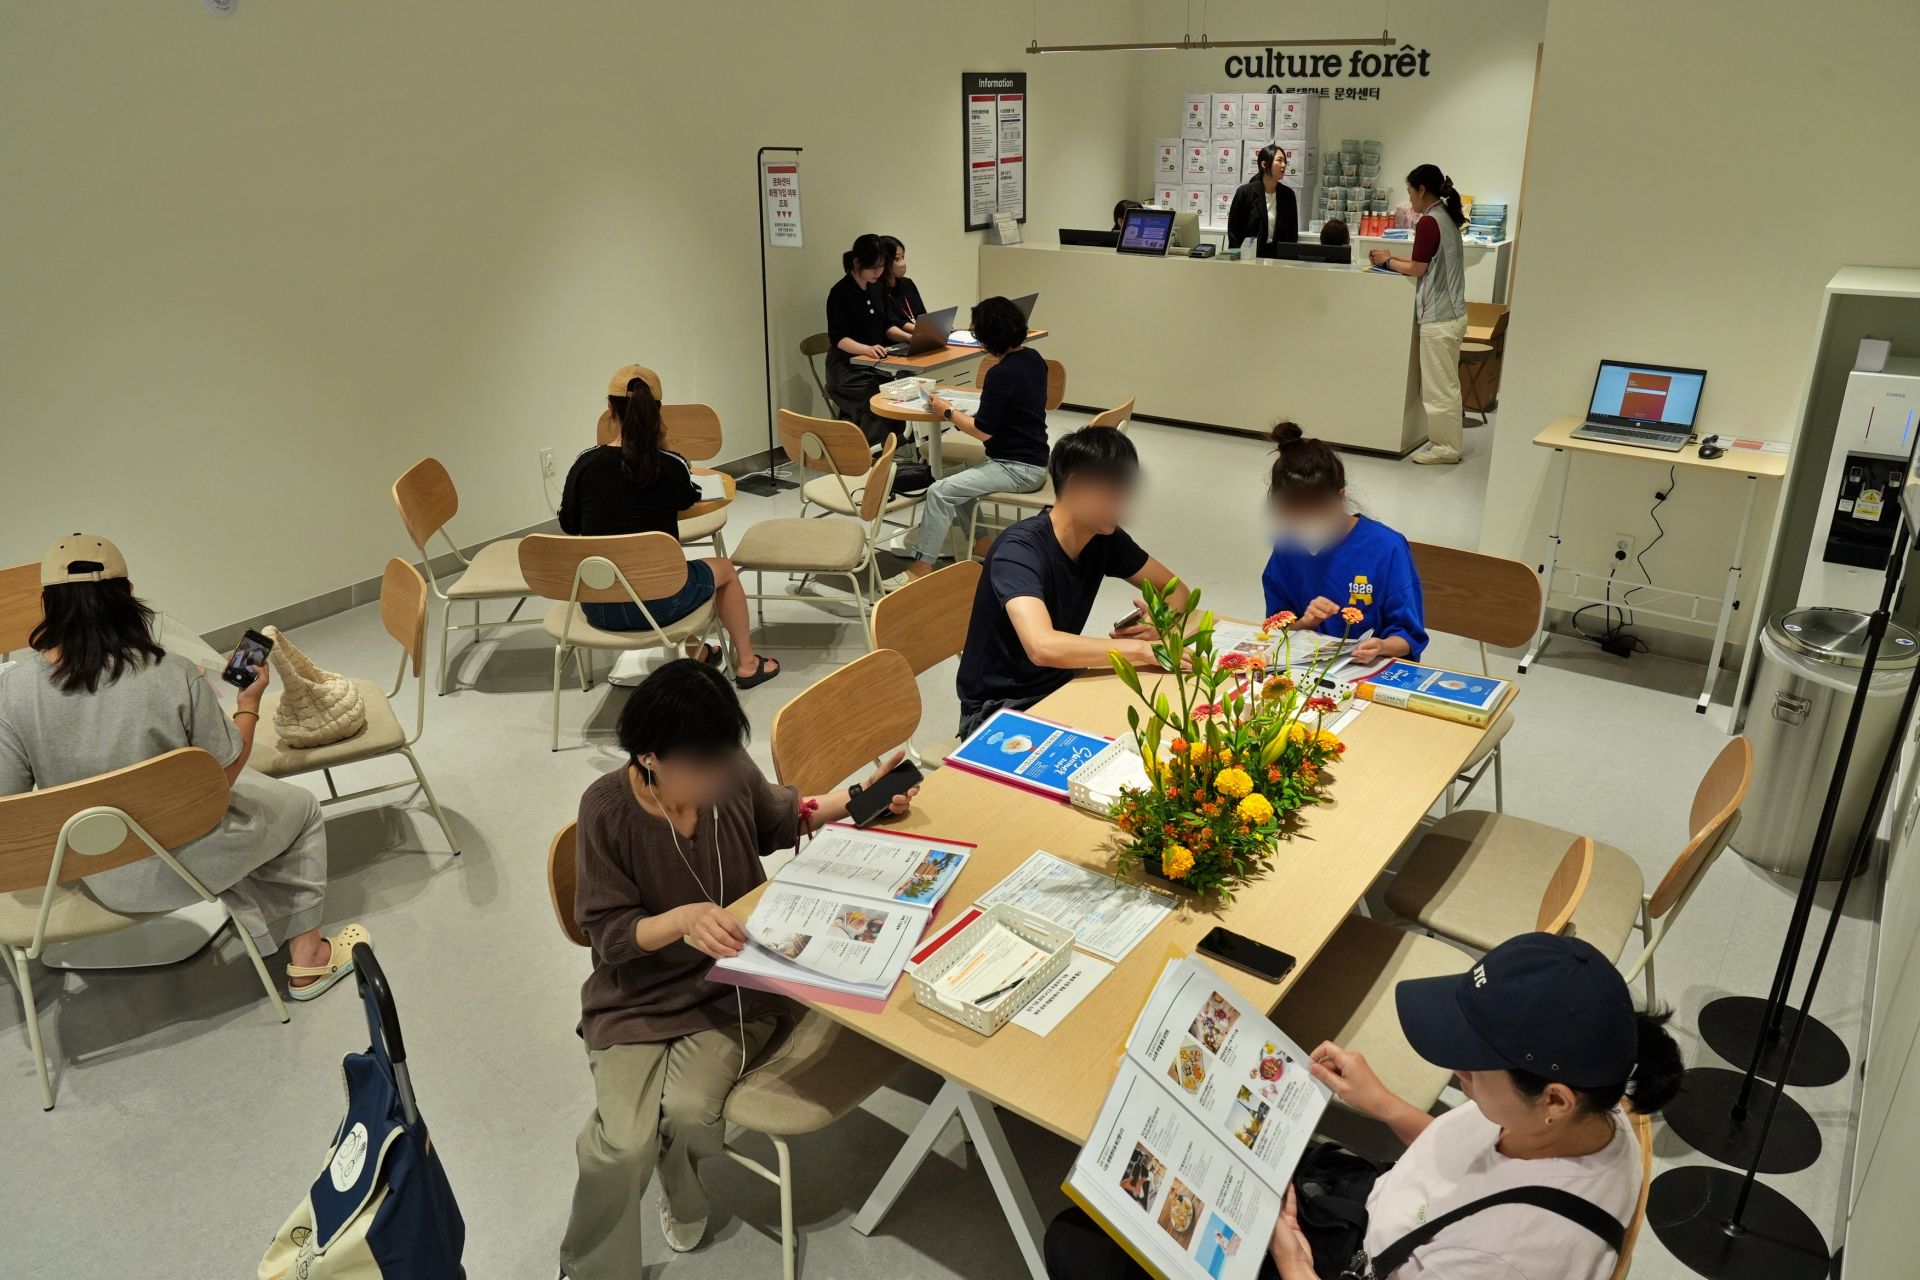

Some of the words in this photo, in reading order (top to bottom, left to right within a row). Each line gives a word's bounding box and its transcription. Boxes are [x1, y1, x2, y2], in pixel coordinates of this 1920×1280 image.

[1224, 48, 1342, 79] culture
[1348, 44, 1431, 78] forêt
[978, 78, 1014, 88] Information
[1334, 87, 1380, 100] 문화센터
[1348, 582, 1373, 594] 1928
[1473, 963, 1487, 988] NYC
